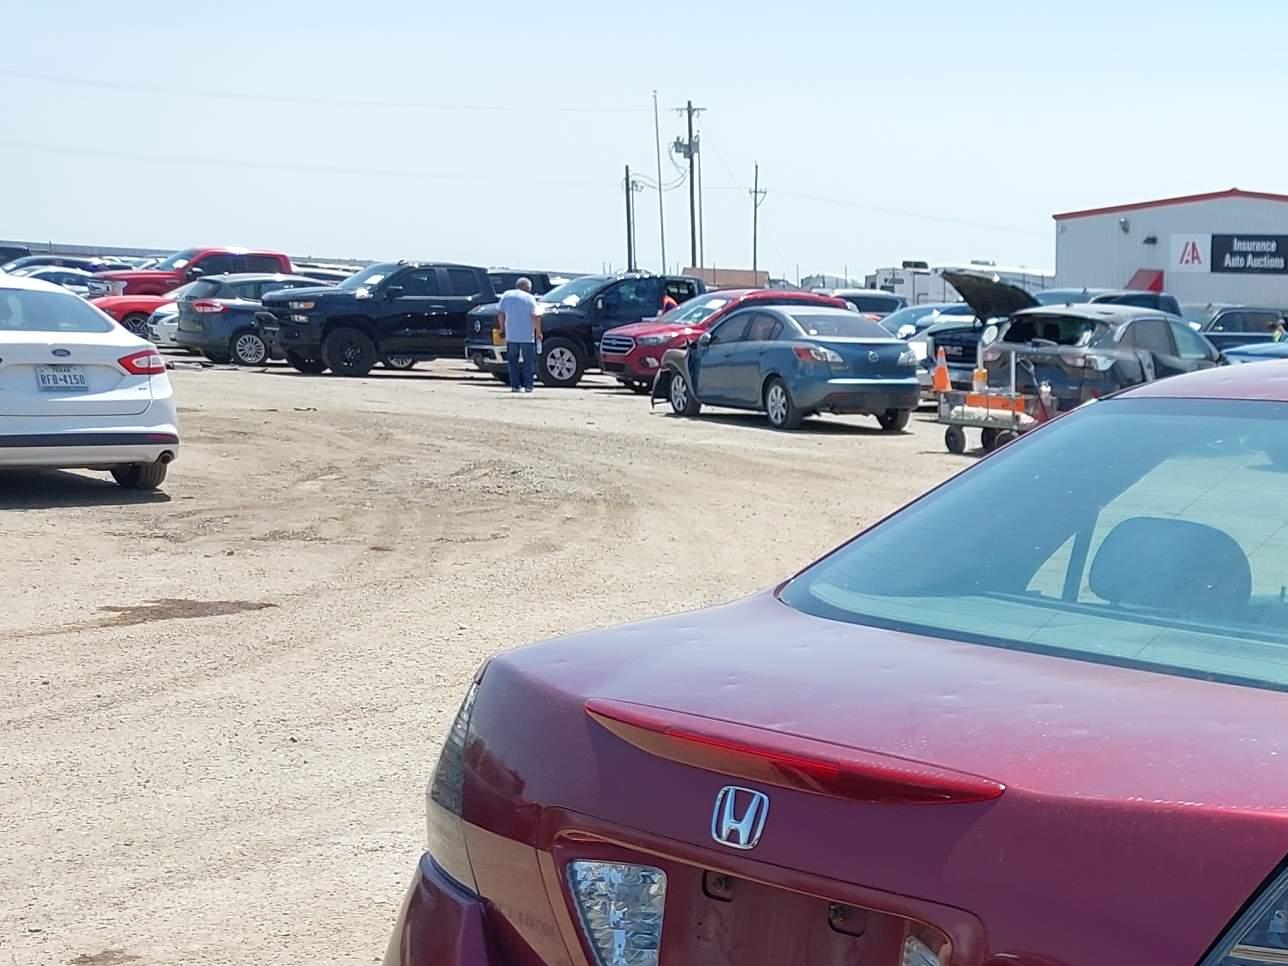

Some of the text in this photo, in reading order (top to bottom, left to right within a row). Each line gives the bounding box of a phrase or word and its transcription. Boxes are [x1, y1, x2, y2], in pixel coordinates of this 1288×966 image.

[1233, 238, 1277, 252] Insurance
[1224, 253, 1285, 268] Auto Auctions
